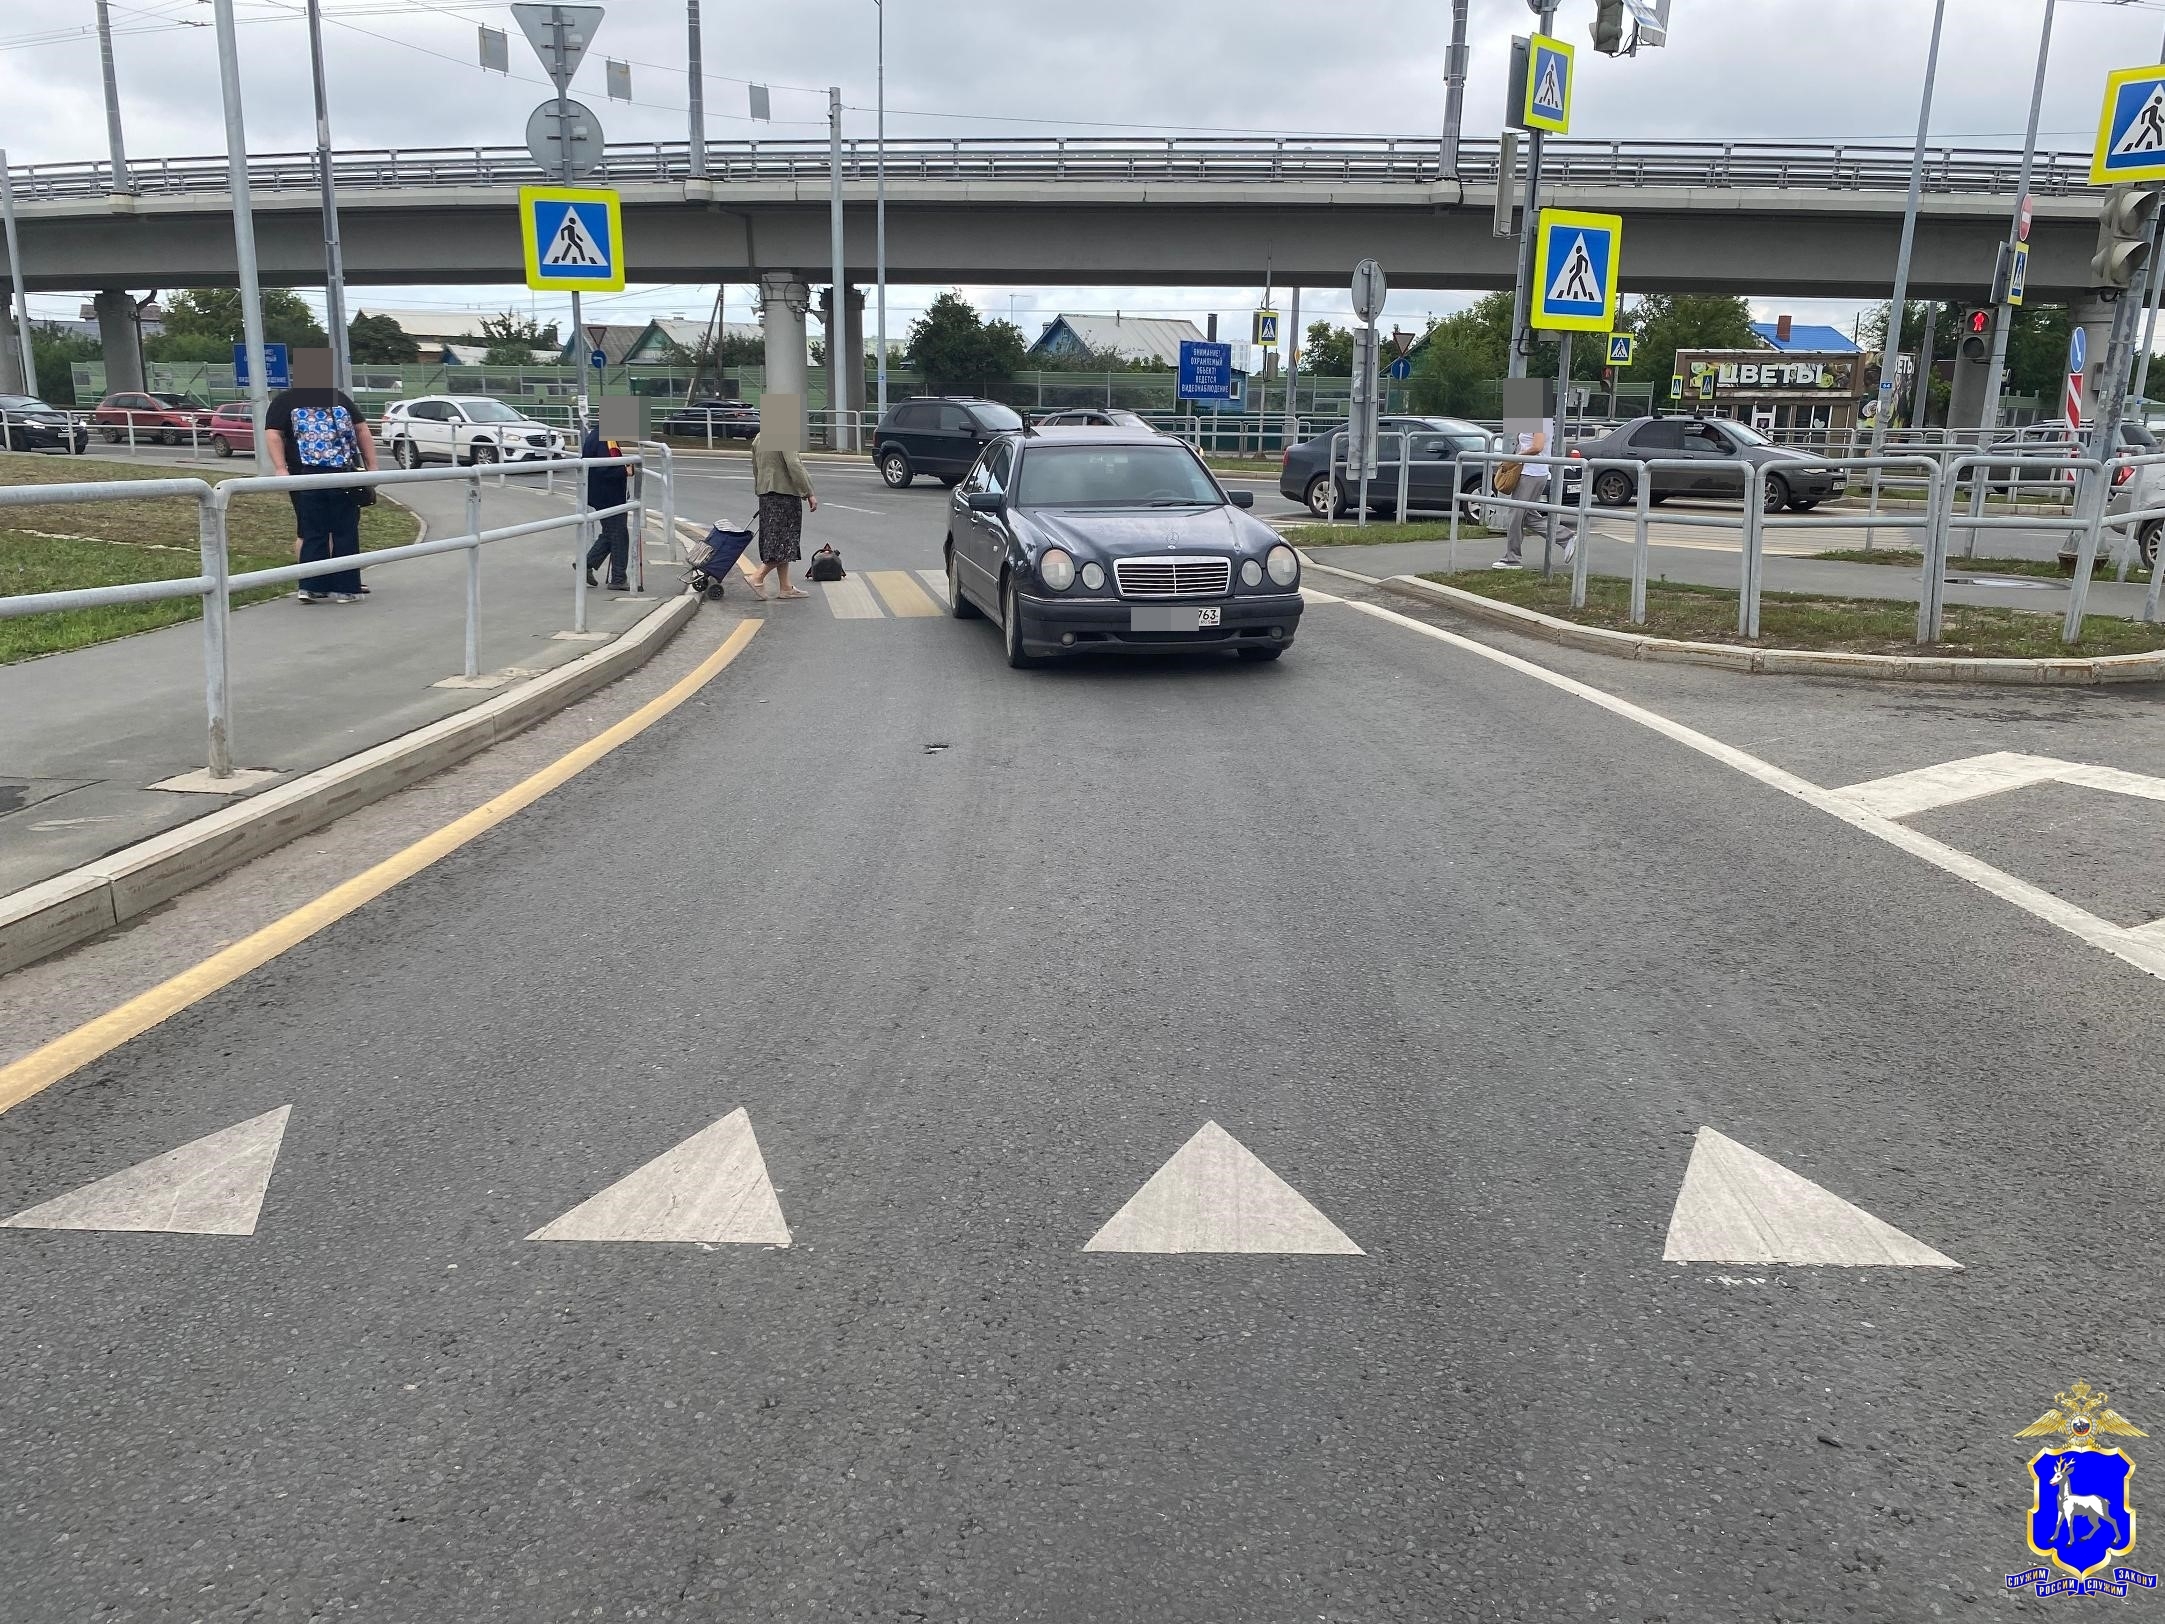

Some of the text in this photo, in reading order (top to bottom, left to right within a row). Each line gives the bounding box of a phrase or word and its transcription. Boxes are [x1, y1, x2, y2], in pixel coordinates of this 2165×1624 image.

[1718, 362, 1824, 386] ЦВЕТЫ
[1895, 355, 1916, 374] ЕТЫ
[1181, 384, 1229, 393] ВИДЕОНАБЛЮДЕНИЕ
